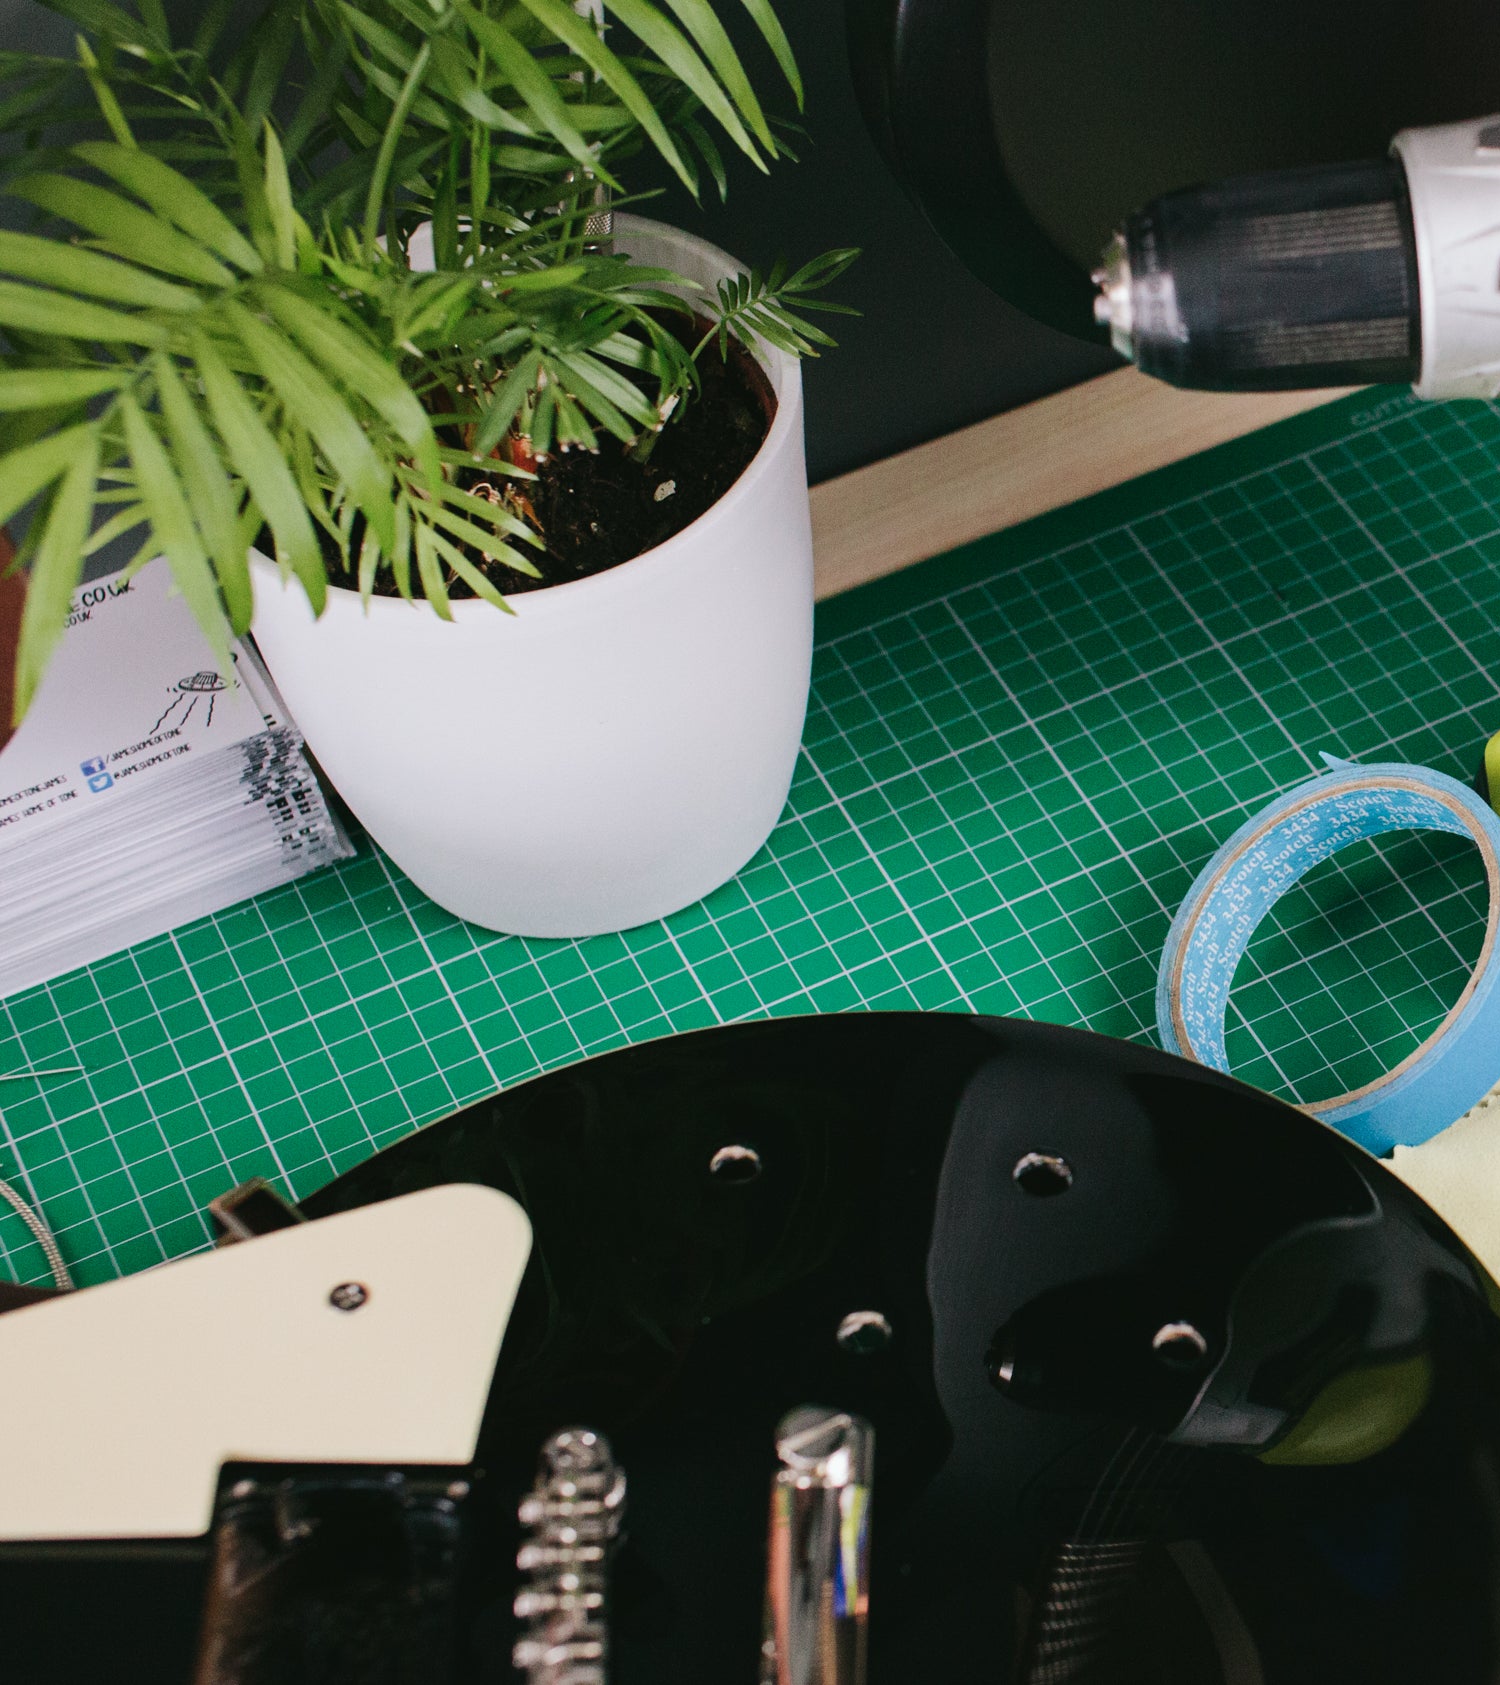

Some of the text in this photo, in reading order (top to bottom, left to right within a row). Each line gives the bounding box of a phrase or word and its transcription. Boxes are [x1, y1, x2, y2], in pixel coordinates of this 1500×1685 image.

[1329, 807, 1369, 829] 3434
[1335, 793, 1392, 813] Scotch
[1281, 811, 1320, 840] 3434
[1306, 824, 1362, 857] Scotch
[1222, 850, 1268, 899] Scotch
[1260, 833, 1312, 875] Scotch
[1260, 863, 1294, 899] 3434
[1223, 884, 1252, 925] 3434
[1194, 911, 1217, 954] 3434
[1217, 914, 1251, 968] Scotch
[1195, 942, 1219, 998] Scotch
